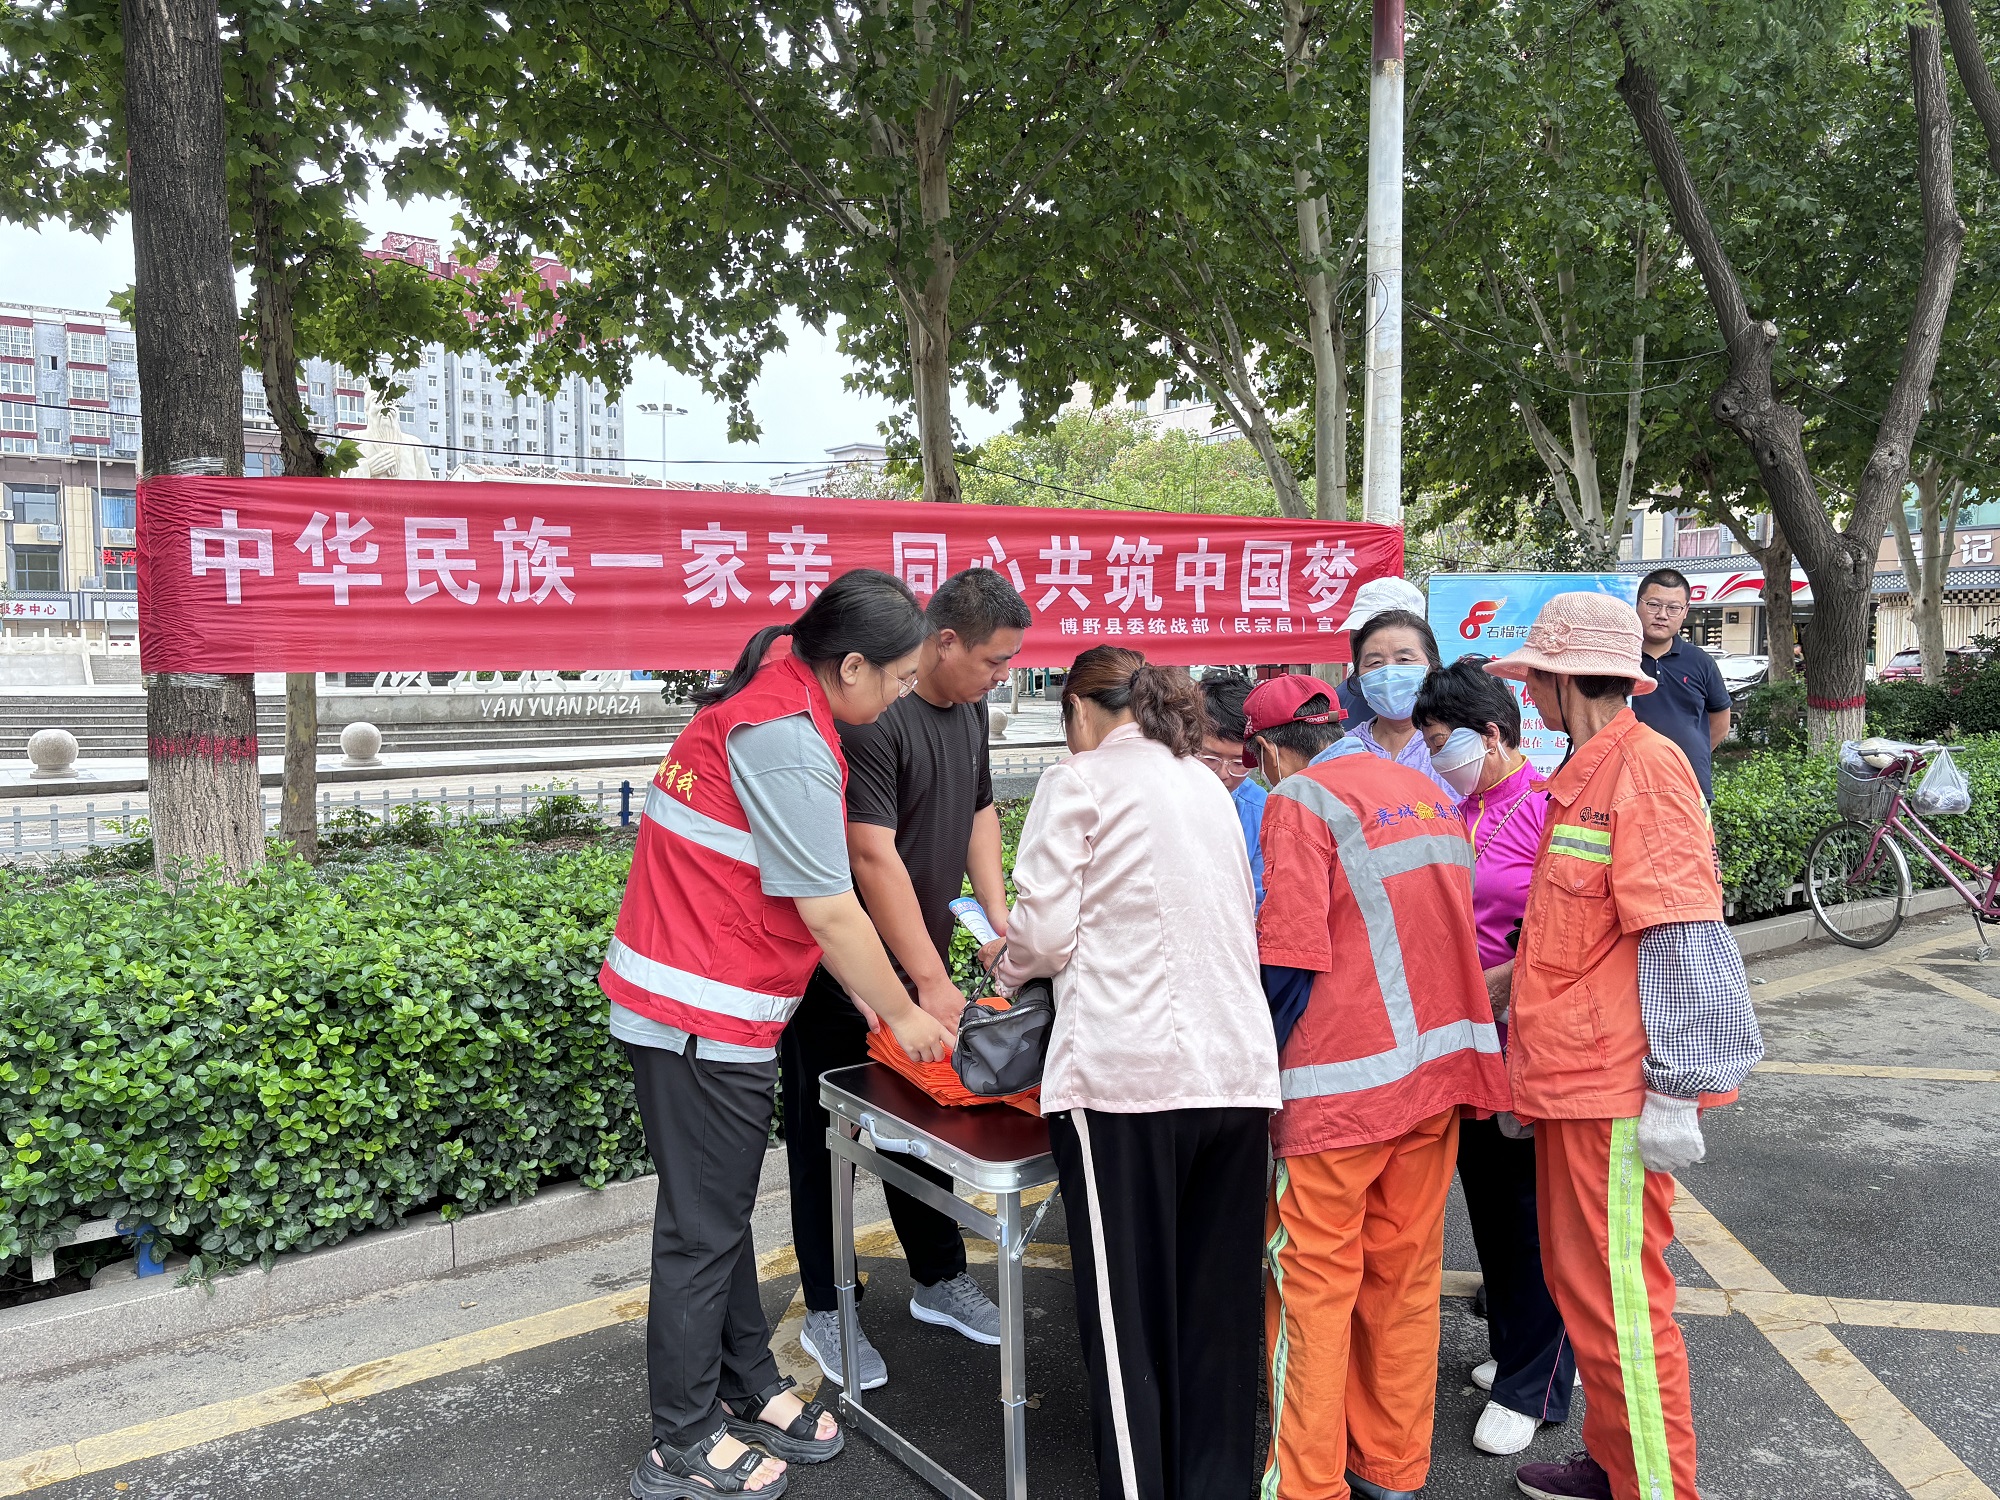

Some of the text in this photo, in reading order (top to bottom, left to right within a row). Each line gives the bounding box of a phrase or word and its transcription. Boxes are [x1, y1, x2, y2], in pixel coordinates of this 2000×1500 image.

[189, 508, 1358, 614] 中华民族一家亲 同心共筑中国梦
[1059, 616, 1335, 635] 博野县委统战部（民宗局）宣
[585, 694, 642, 715] PLAZA
